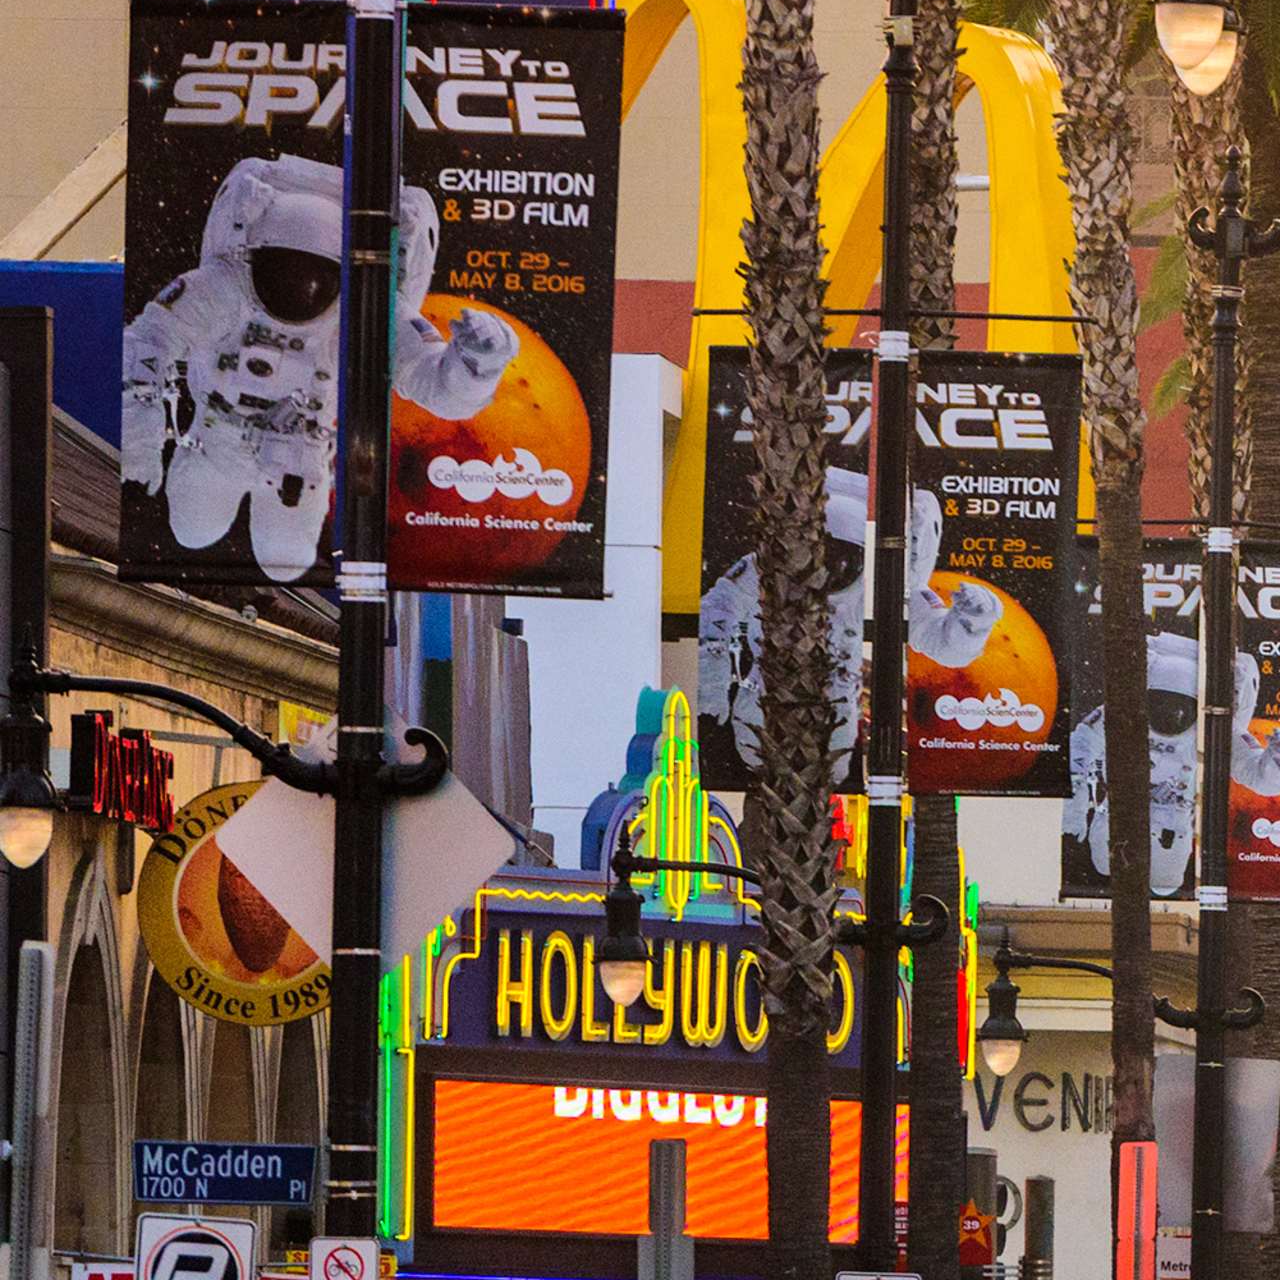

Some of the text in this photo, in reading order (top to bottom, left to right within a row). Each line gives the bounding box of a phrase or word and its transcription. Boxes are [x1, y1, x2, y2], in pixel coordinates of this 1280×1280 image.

[520, 60, 570, 78] TO
[438, 168, 595, 197] EXHIBITION
[442, 198, 590, 227] & 3D FILM
[520, 252, 551, 270] 29
[450, 271, 497, 289] MAY
[532, 274, 586, 293] 2016
[824, 381, 1042, 406] URNEY TO
[941, 475, 1060, 496] EXHIBITION
[944, 498, 1057, 519] & 3D FILM
[405, 511, 595, 533] California Science Center
[1003, 538, 1027, 553] 29
[949, 552, 986, 568] MAY
[1012, 556, 1054, 571] 2016
[1261, 660, 1274, 675] &
[919, 737, 1061, 754] California Science Center
[176, 965, 333, 1018] Since 1989
[142, 1145, 283, 1179] McCadden
[142, 1176, 186, 1198] 1700
[195, 1178, 209, 1199] N
[1160, 1260, 1192, 1272] Metr
